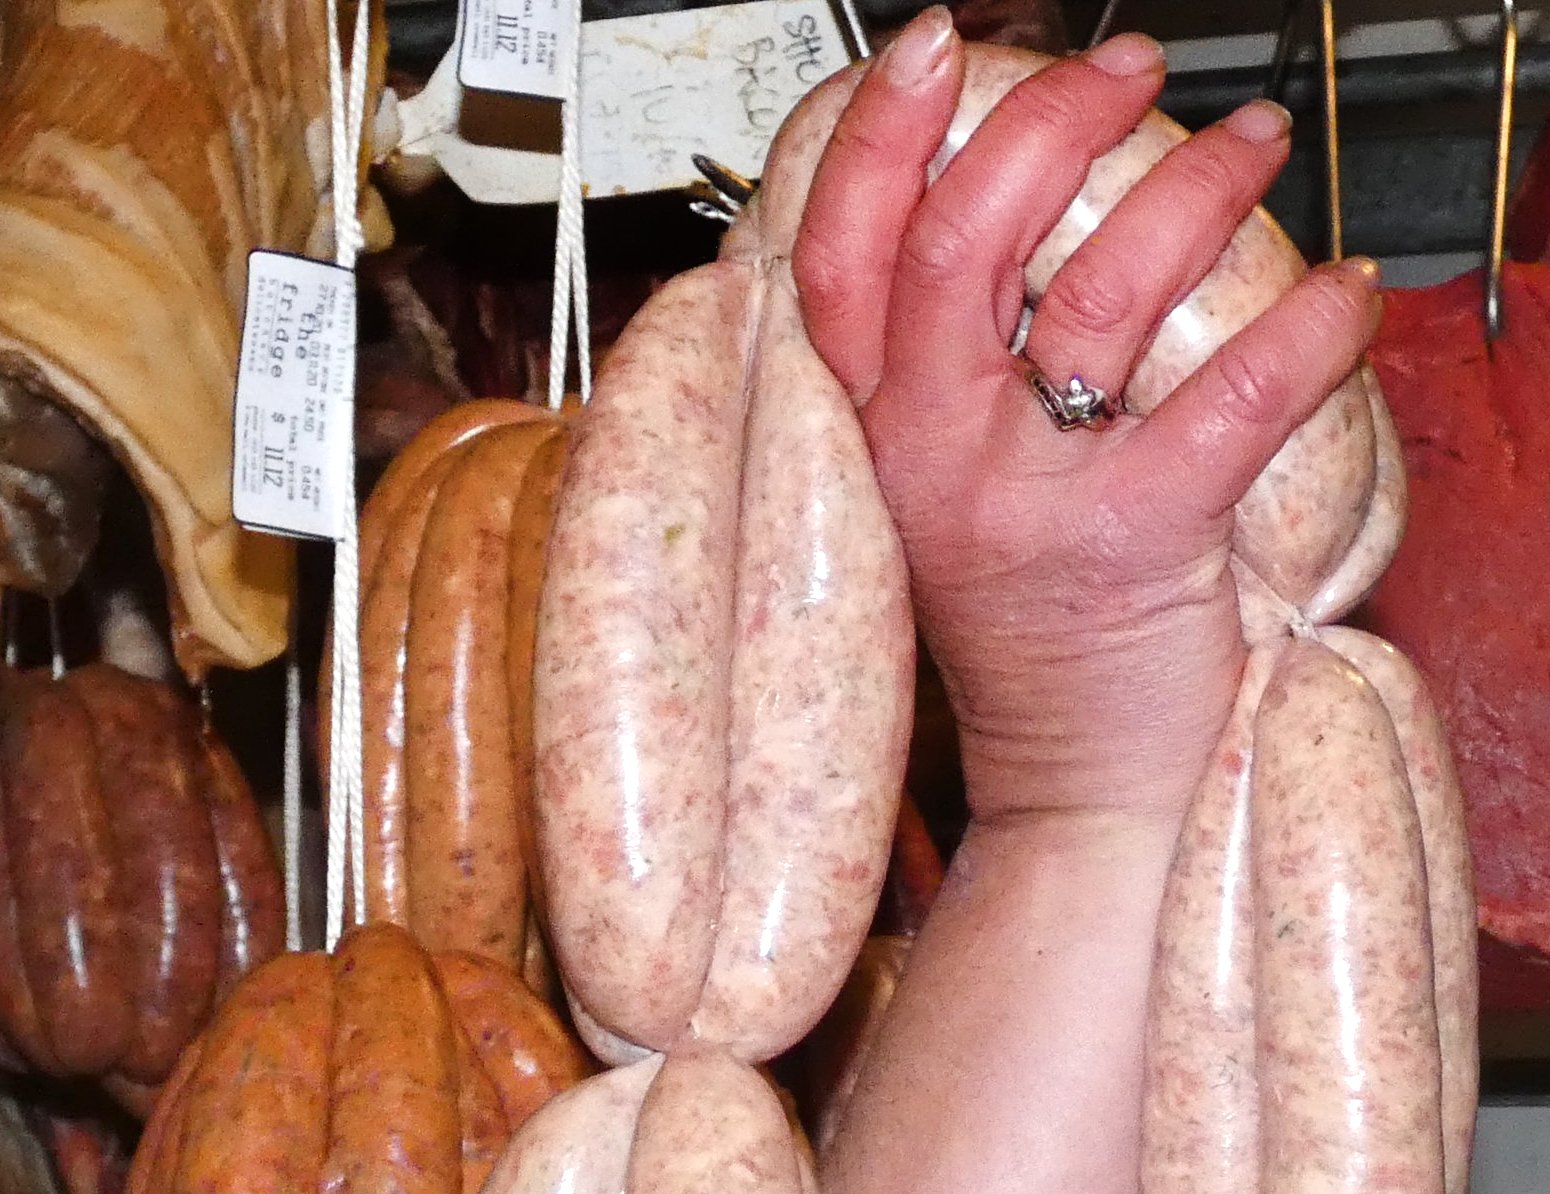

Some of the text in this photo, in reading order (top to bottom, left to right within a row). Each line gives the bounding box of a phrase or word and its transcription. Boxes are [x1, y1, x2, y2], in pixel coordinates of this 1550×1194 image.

[495, 14, 519, 54] 11.12
[270, 283, 299, 379] fridge
[296, 312, 318, 360] the
[263, 411, 286, 489] $ 11.12
